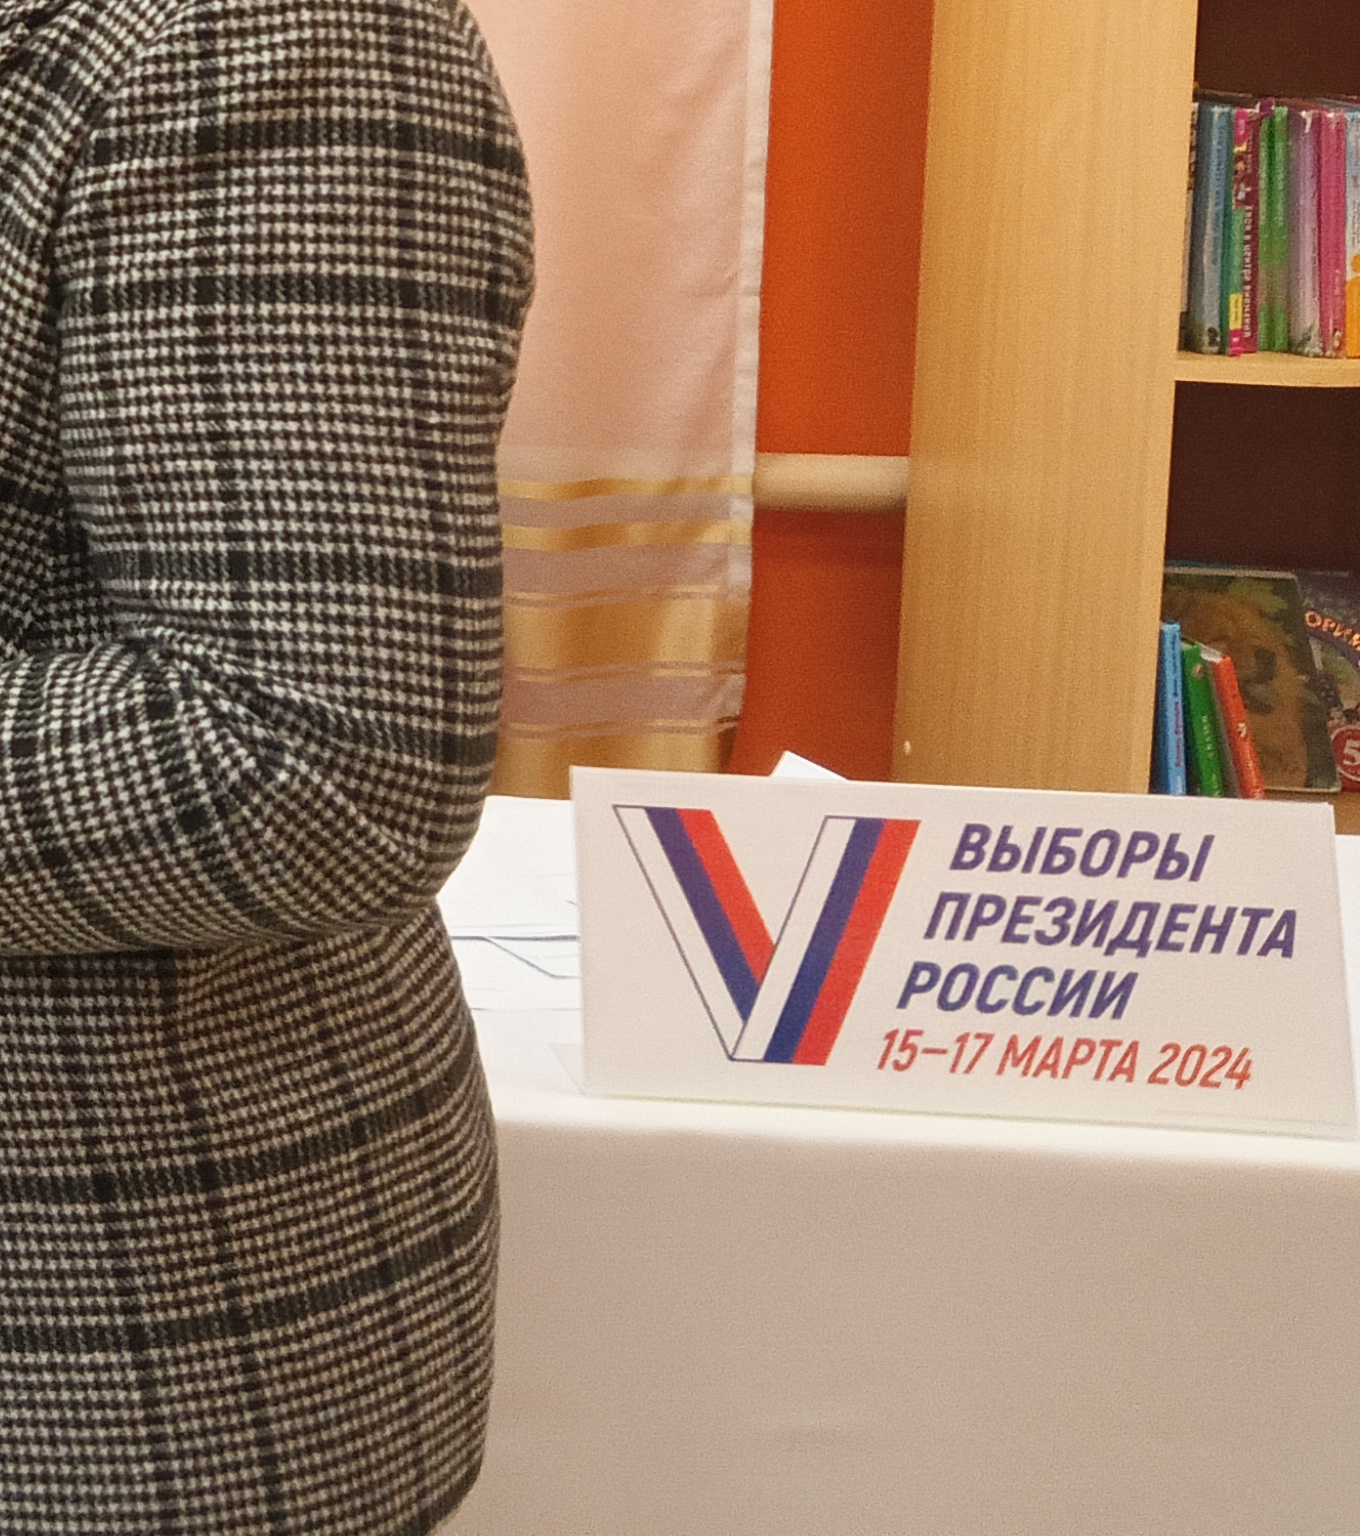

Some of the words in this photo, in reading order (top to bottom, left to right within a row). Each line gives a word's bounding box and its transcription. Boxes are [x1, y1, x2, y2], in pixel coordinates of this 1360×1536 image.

[949, 822, 1215, 883] ВЫБОРЫ
[924, 892, 1298, 958] ПРЕЗИДЕНТА
[897, 961, 1139, 1020] РОССИИ
[997, 1034, 1138, 1085] МАРТА
[1147, 1043, 1253, 1091] 2024
